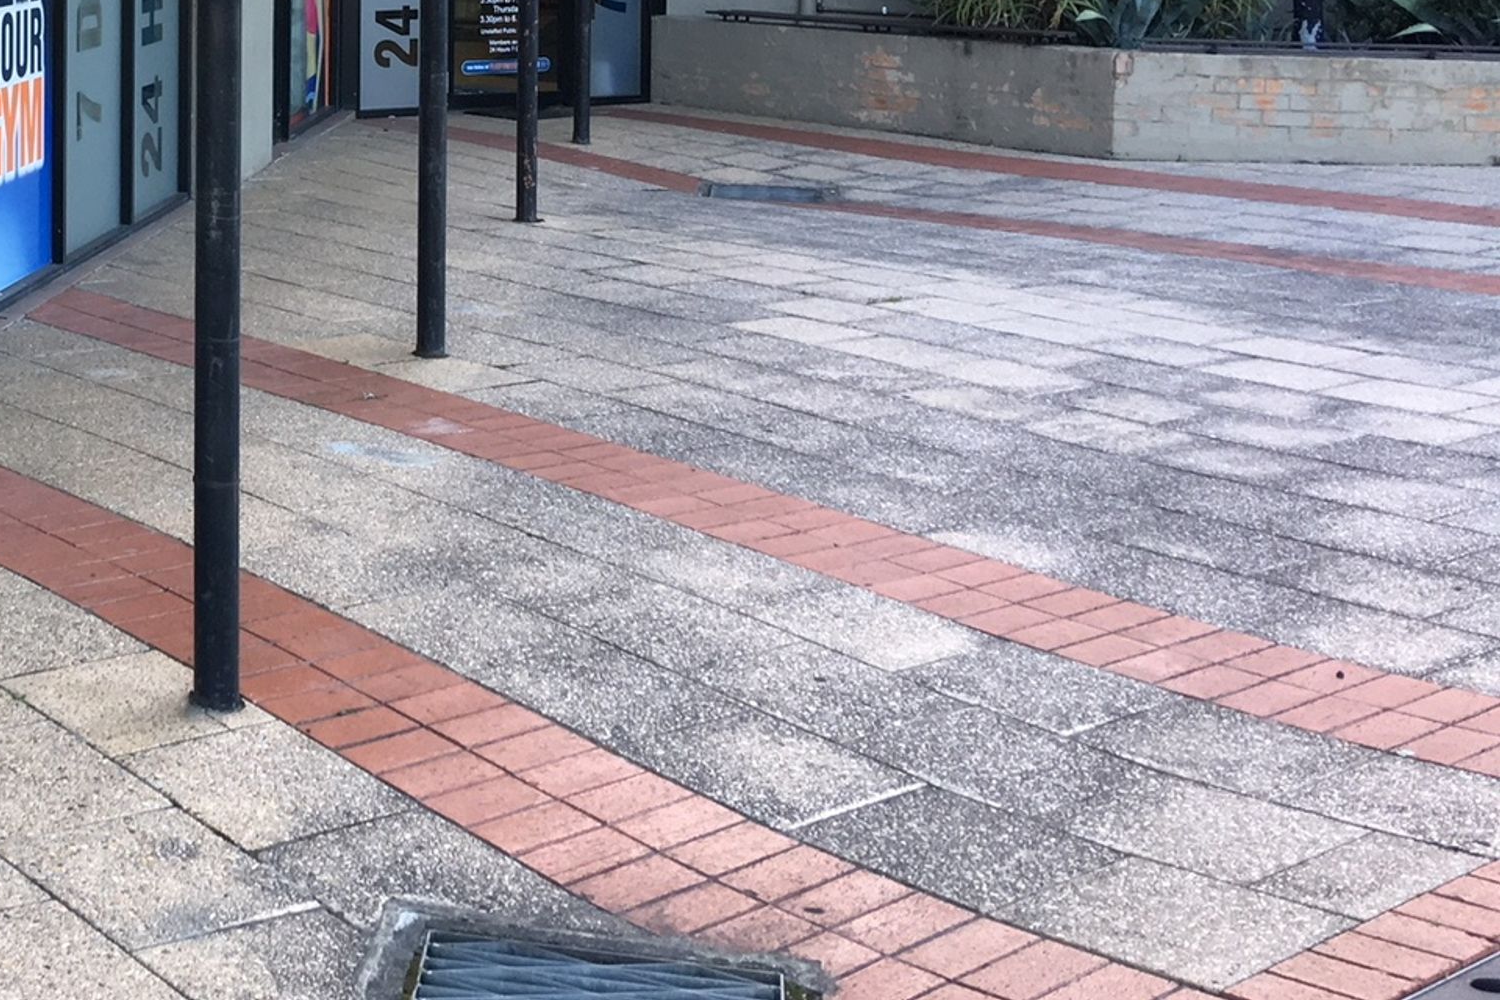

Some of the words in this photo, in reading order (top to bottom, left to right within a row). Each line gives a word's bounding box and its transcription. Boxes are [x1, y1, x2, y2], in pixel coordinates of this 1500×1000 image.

[374, 5, 419, 68] 24
[494, 5, 519, 14] Thursda
[76, 91, 103, 141] 7
[141, 75, 162, 179] 24
